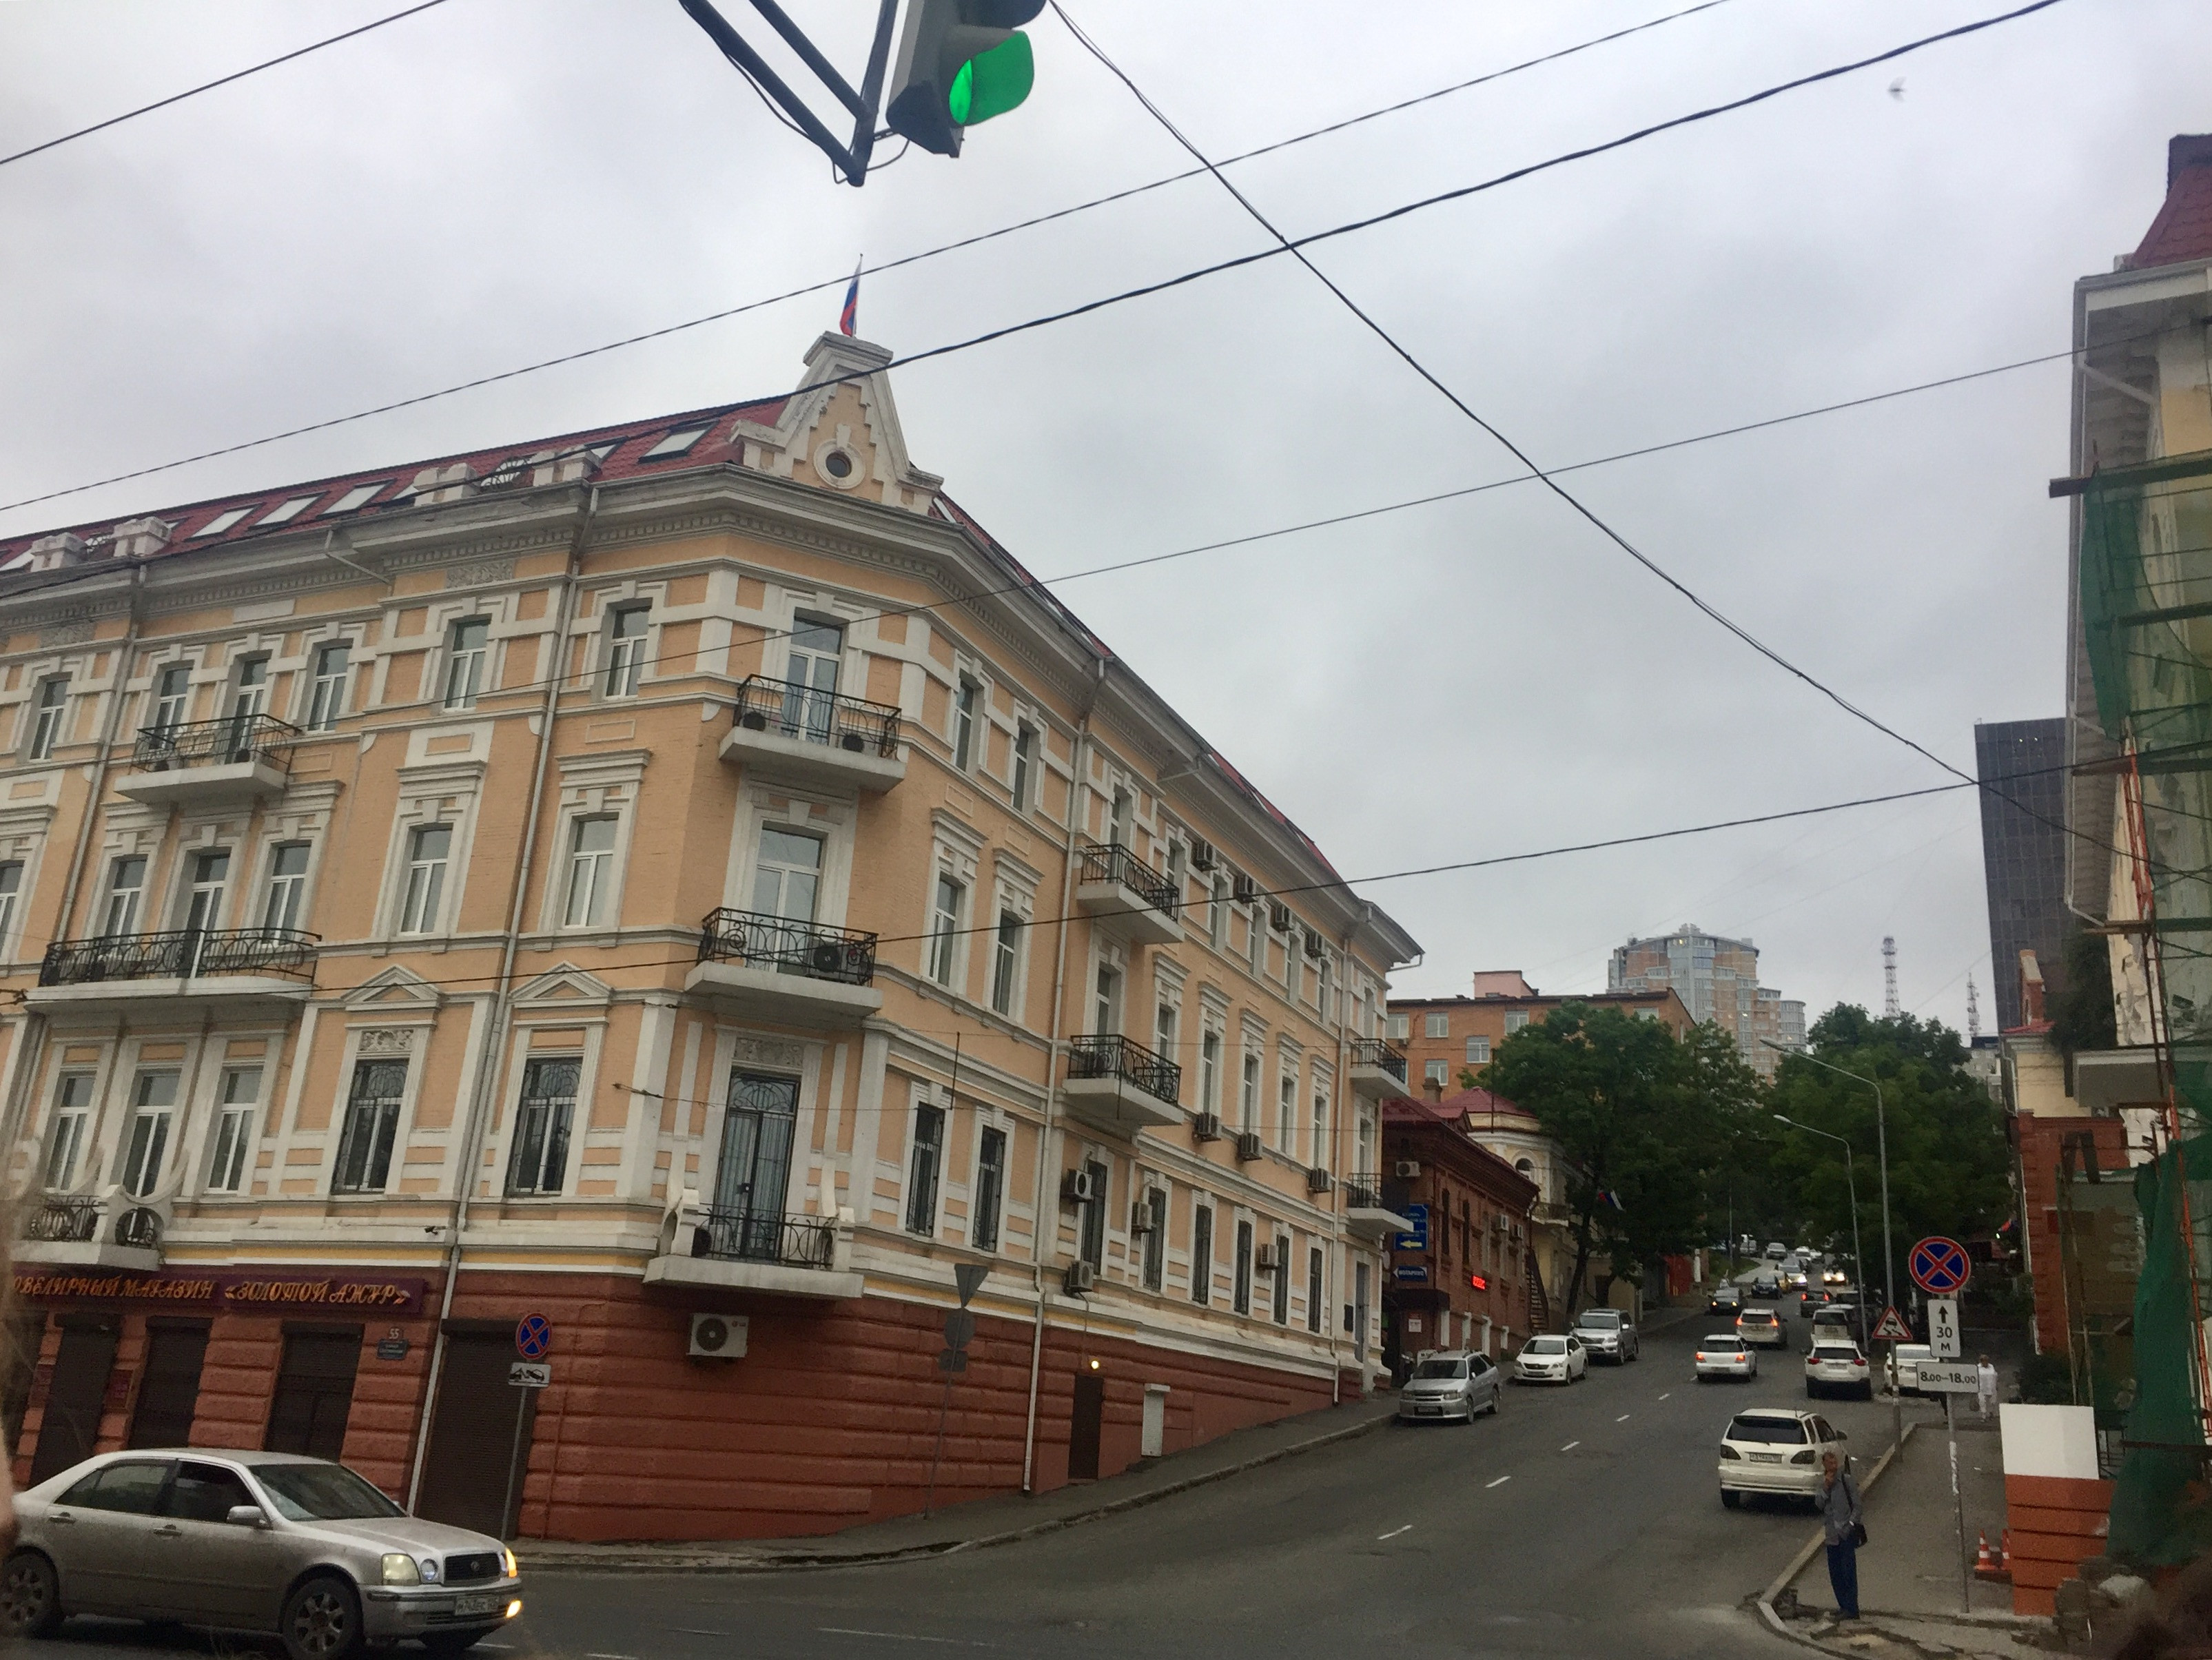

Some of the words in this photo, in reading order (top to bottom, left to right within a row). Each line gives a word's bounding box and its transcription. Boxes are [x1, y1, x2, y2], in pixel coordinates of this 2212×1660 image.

[119, 1279, 215, 1299] МАГАЗИН
[224, 1278, 334, 1303] «ЗОЛОТОЙ
[389, 1328, 400, 1339] 55
[1936, 1326, 1953, 1338] 30
